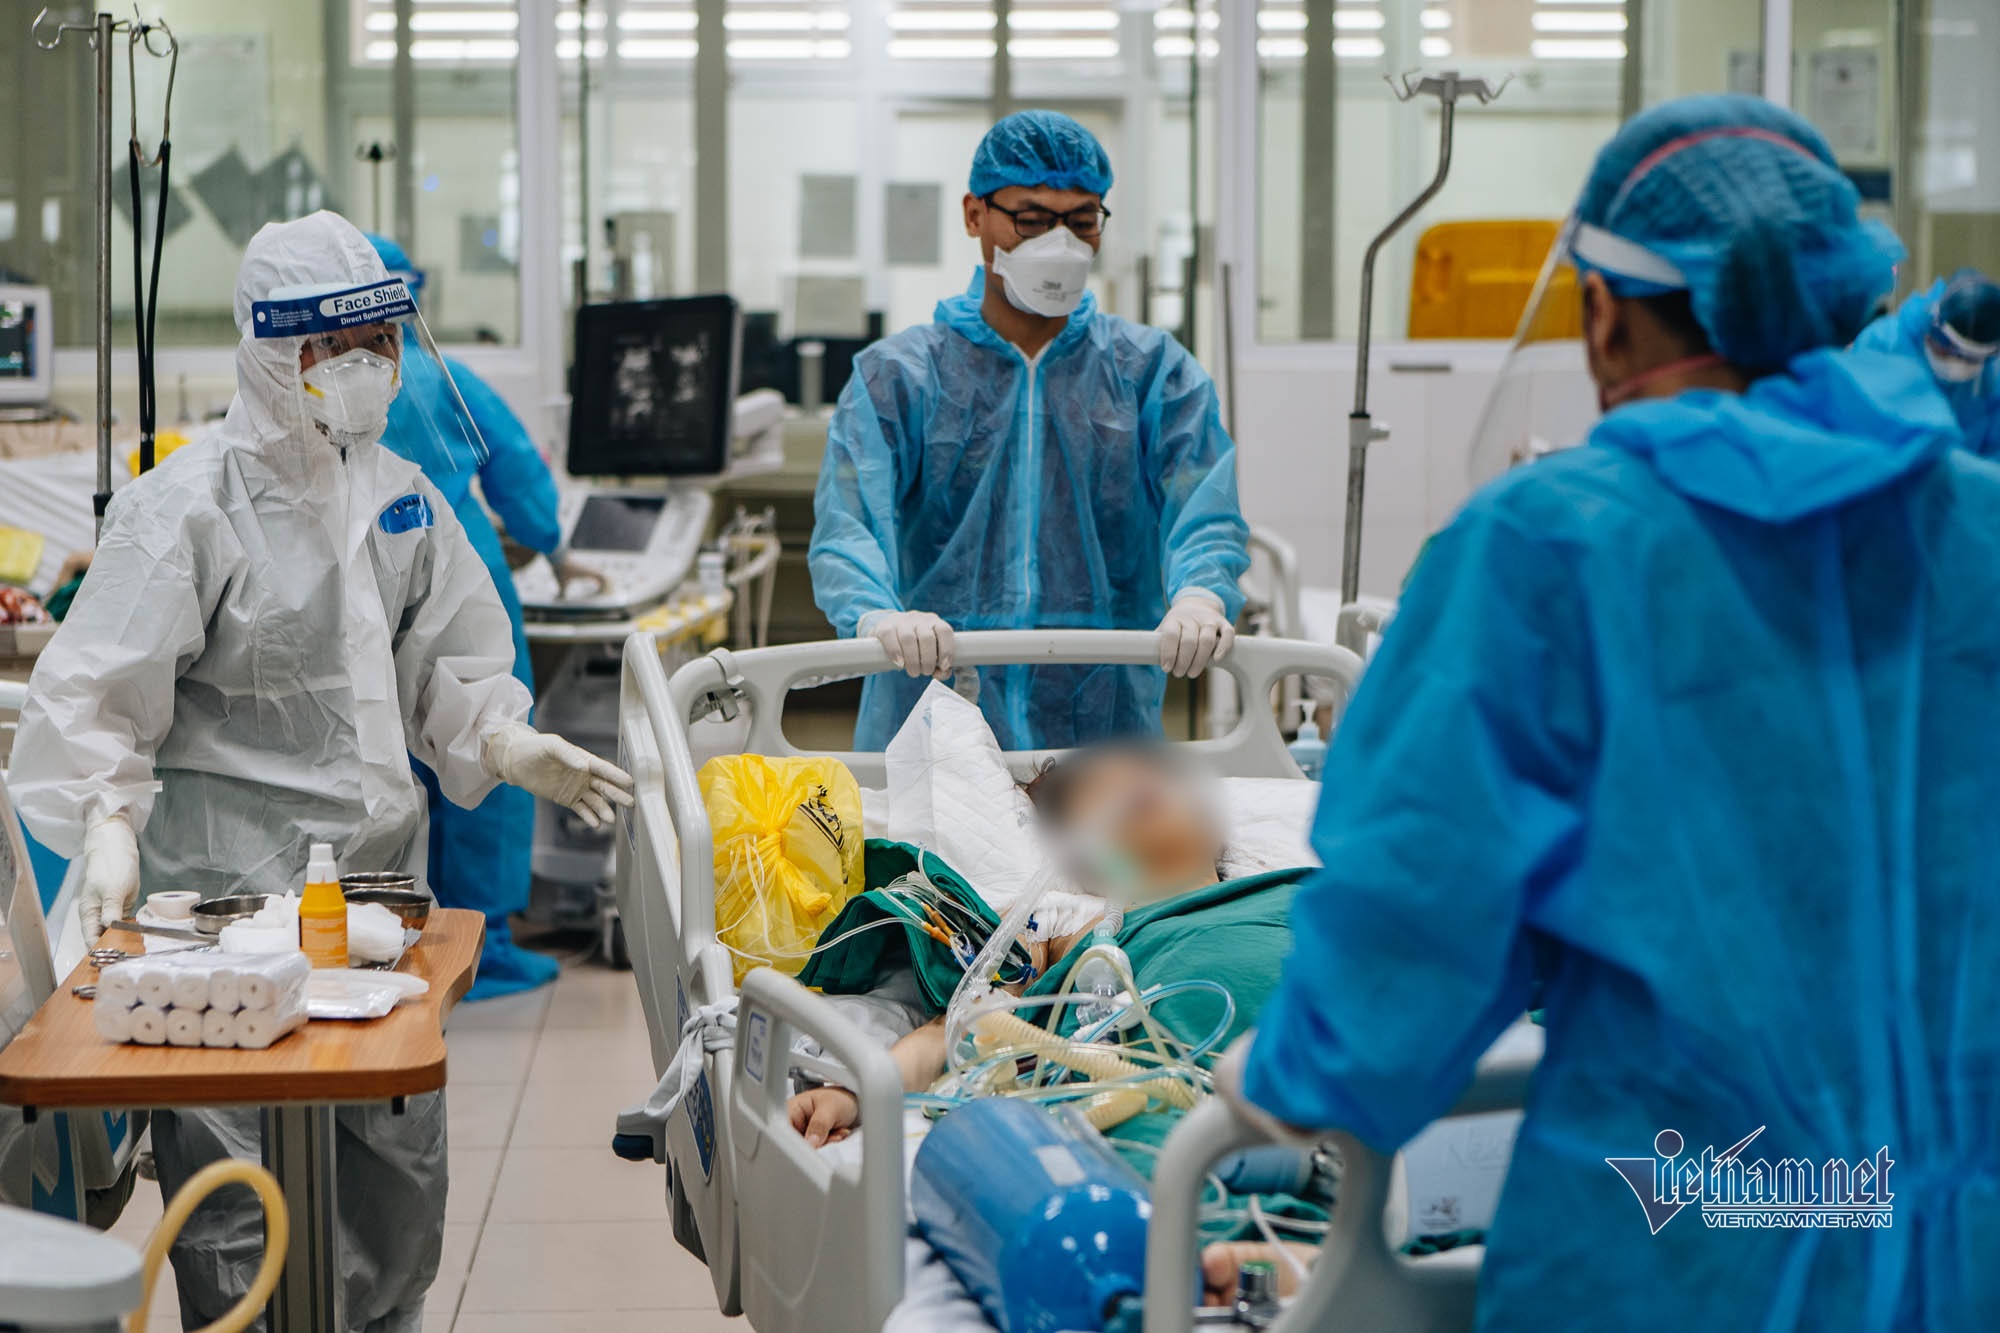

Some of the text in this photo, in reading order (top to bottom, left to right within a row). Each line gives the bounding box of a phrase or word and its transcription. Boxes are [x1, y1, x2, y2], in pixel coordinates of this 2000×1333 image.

[333, 286, 406, 313] Face Shield
[340, 314, 362, 325] Direct
[362, 308, 385, 320] Splash
